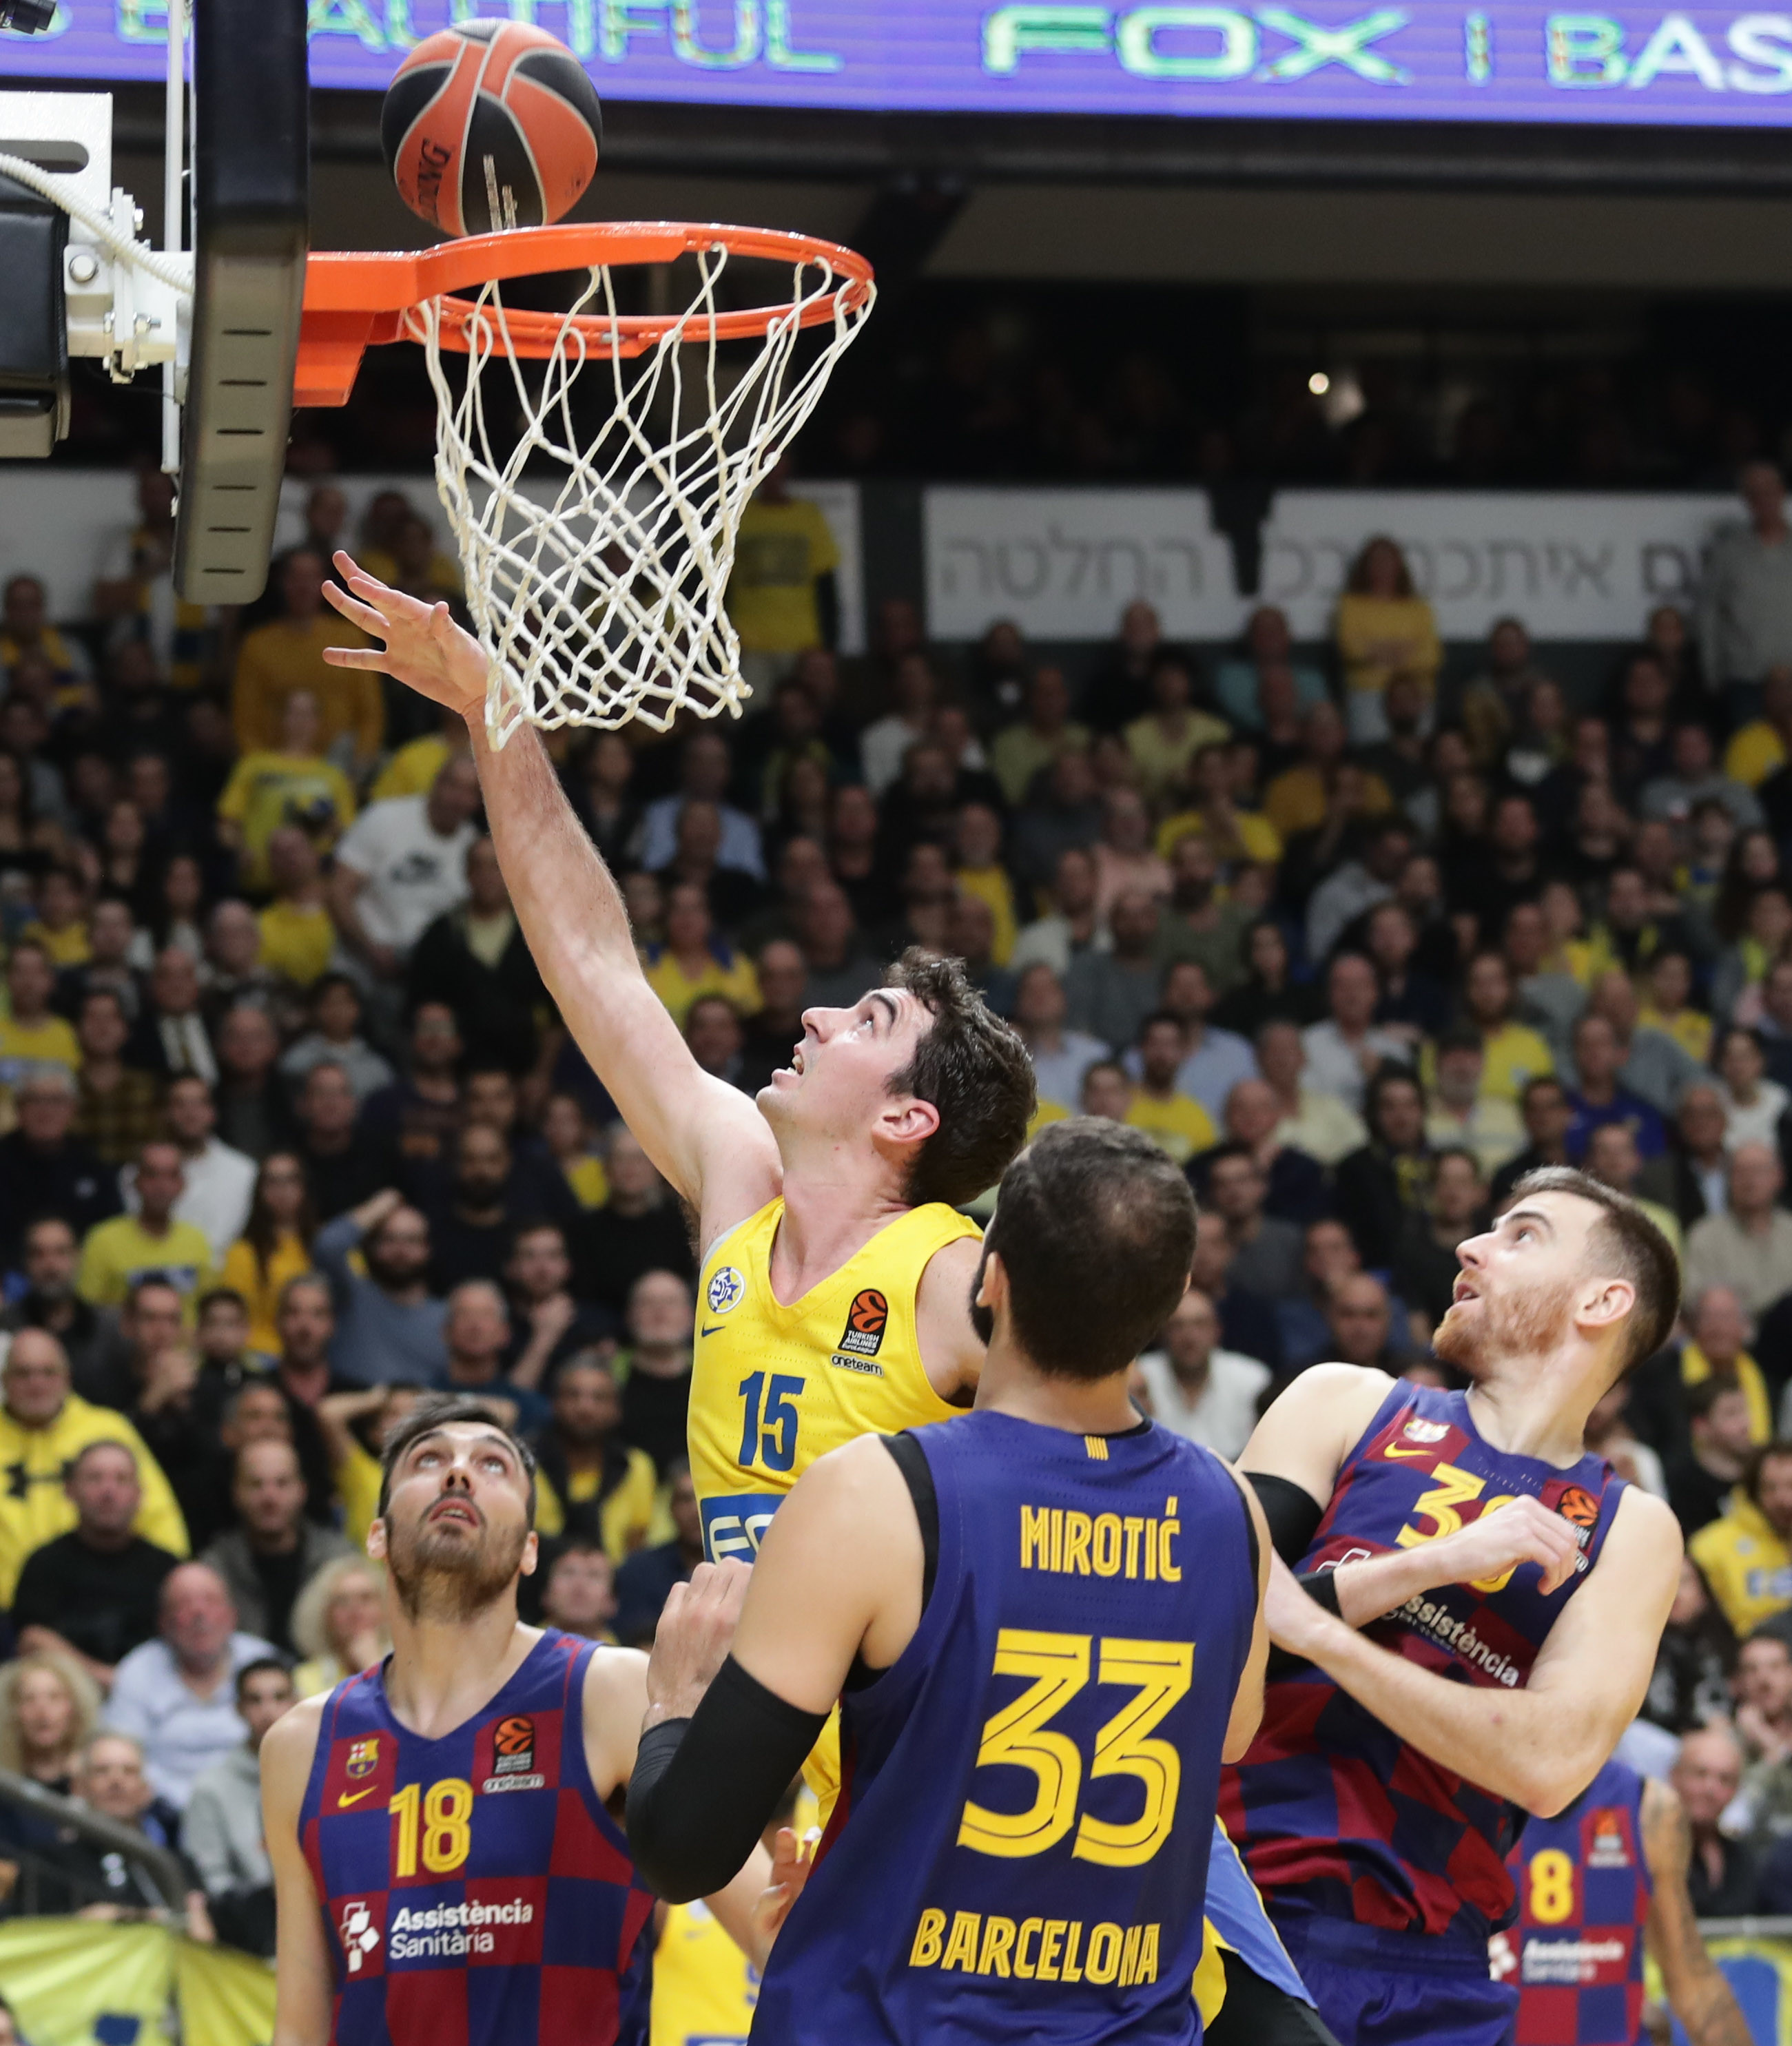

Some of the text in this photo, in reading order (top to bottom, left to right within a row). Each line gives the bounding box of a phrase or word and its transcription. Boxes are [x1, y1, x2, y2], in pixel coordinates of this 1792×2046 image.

[982, 4, 1411, 84] FOX
[832, 1355, 883, 1376] oneteam
[739, 1371, 805, 1471] 15
[1020, 1496, 1182, 1582] MIROTIĆ
[1405, 1595, 1520, 1687] ssistència
[956, 1627, 1196, 1868] 33
[389, 1777, 474, 1878] 18
[391, 1897, 533, 1932] Assistència
[1530, 1849, 1573, 1924] 8
[389, 1927, 495, 1959] Sanitària
[908, 1908, 1161, 1988] BARCELONA
